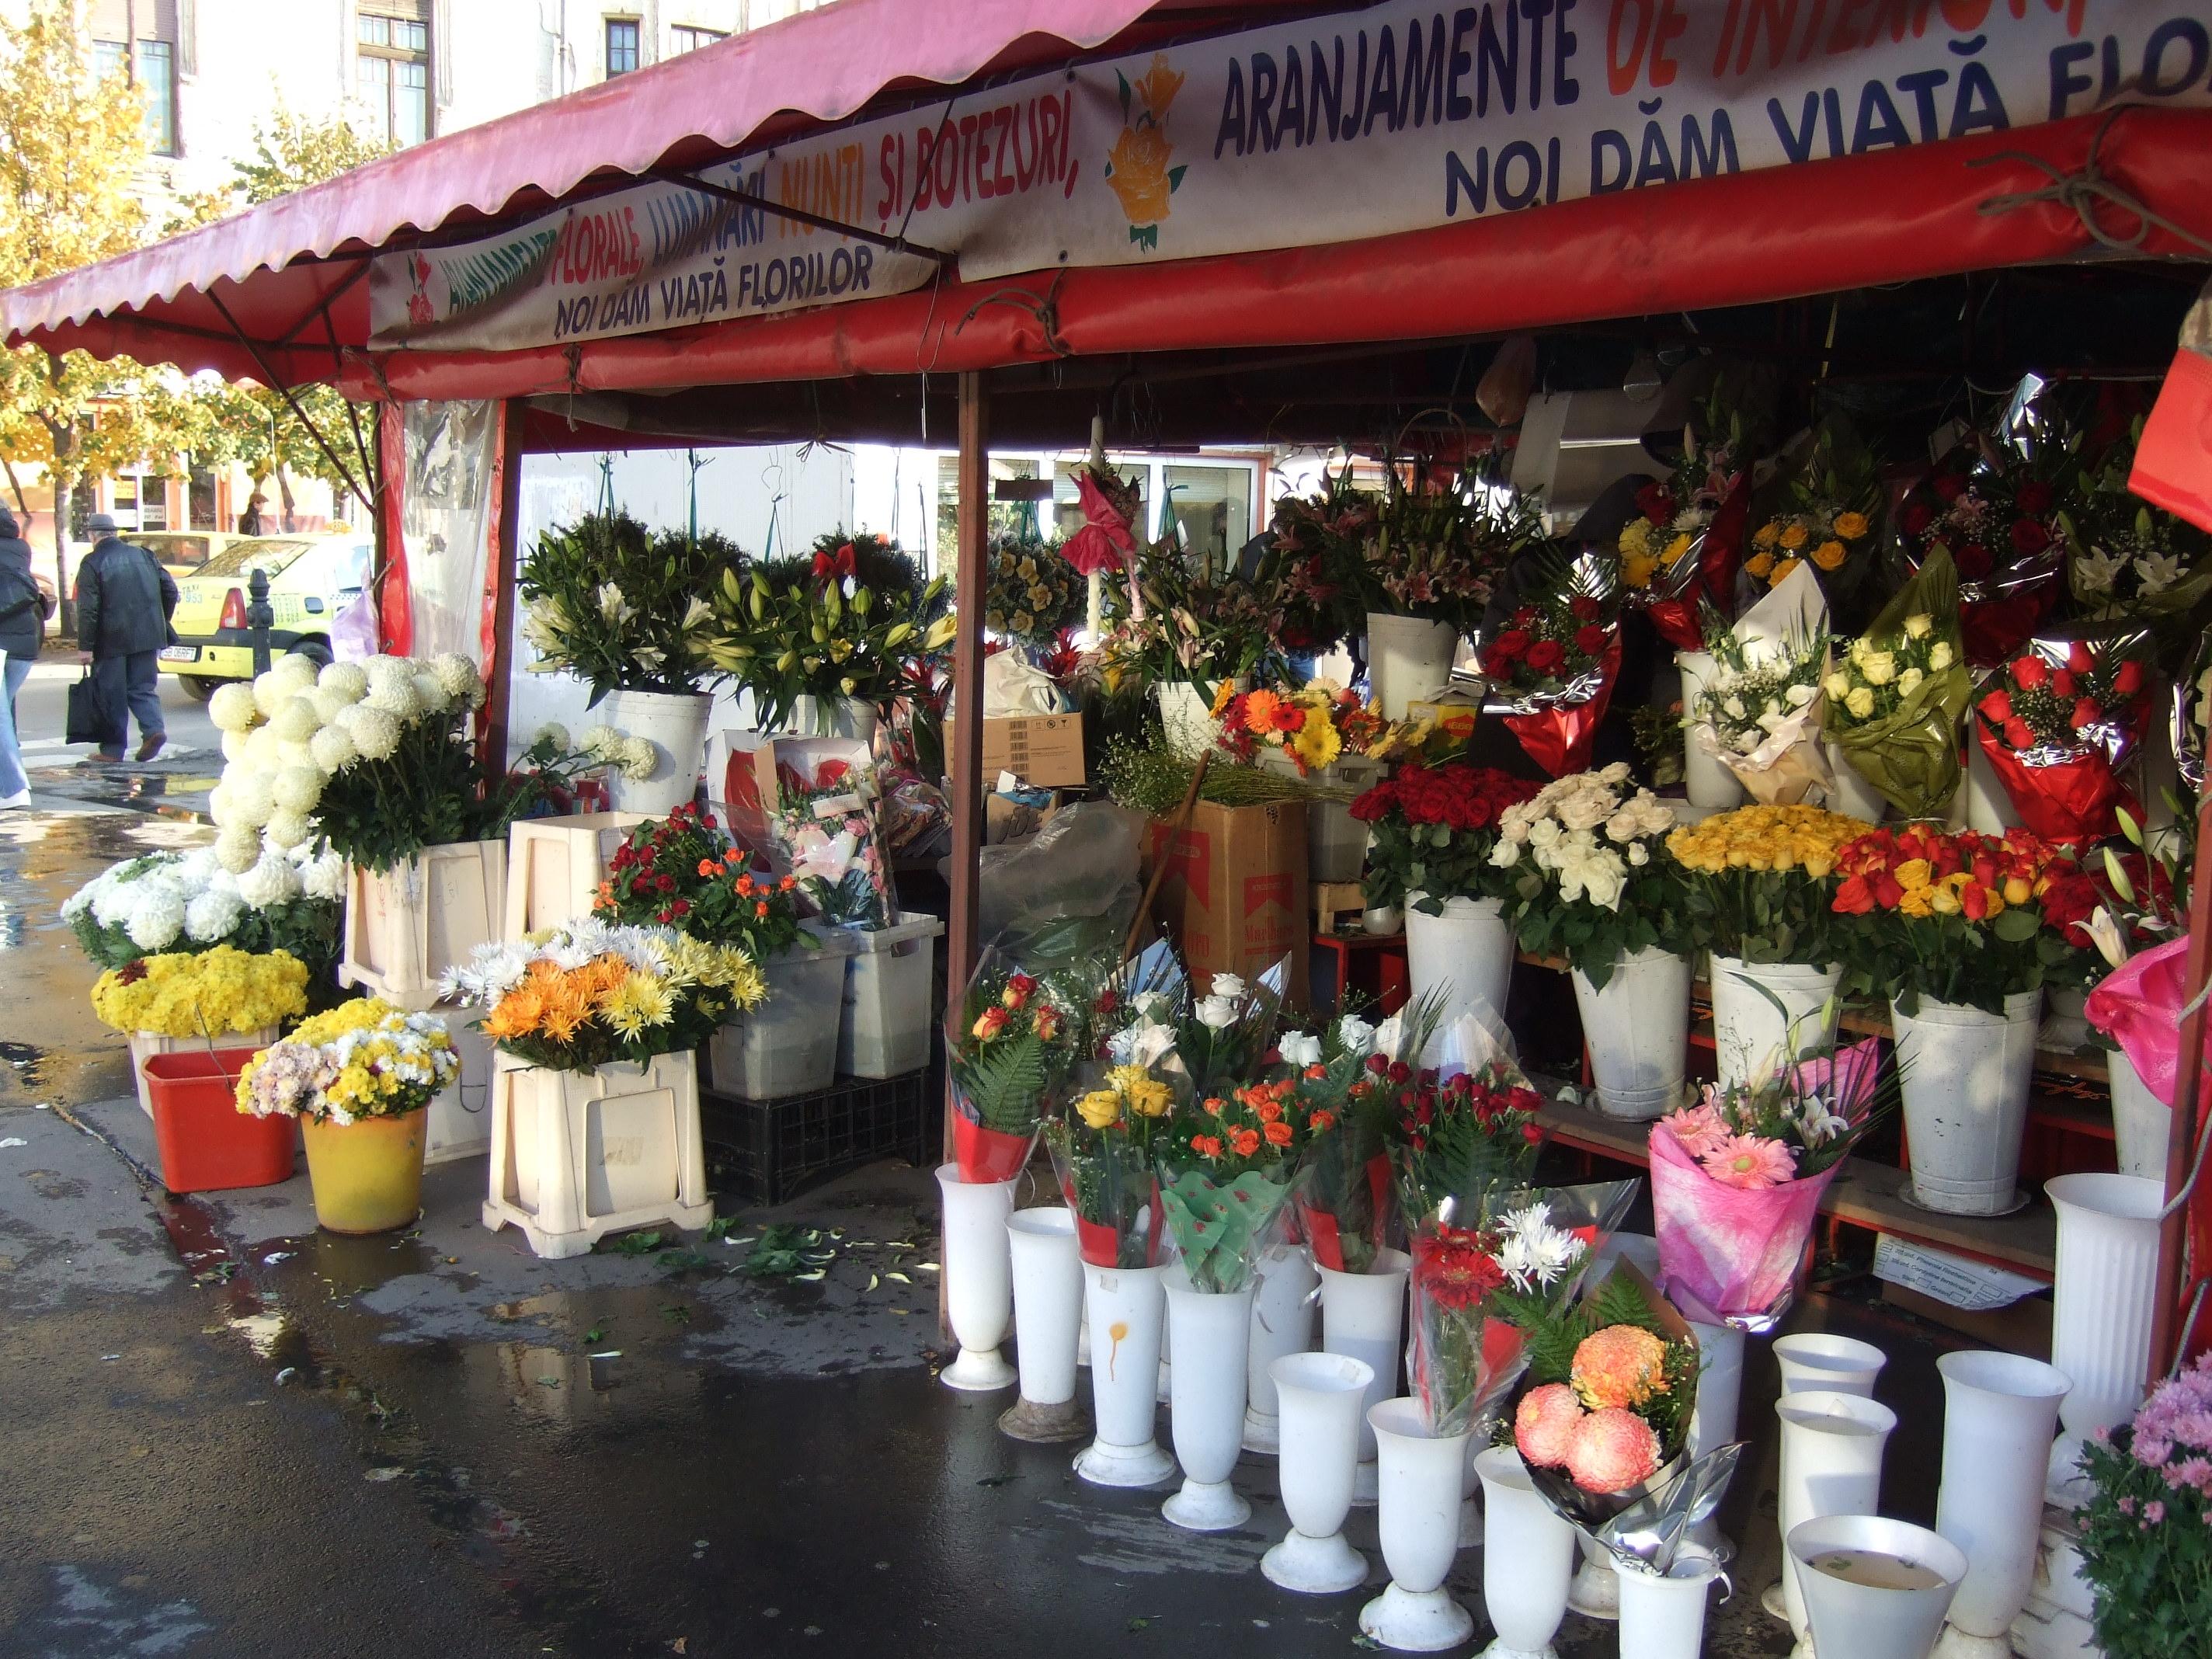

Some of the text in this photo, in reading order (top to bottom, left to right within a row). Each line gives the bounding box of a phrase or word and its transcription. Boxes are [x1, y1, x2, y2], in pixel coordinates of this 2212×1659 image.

[1214, 0, 1579, 159] ARANJAMENTE
[1606, 0, 1689, 96] DE
[552, 206, 644, 285] FLORALE,
[915, 89, 1079, 211] BOTEZURI,
[1445, 137, 1560, 217] NOI
[1590, 96, 1740, 196] DĂM
[555, 294, 598, 336] NOI
[739, 245, 873, 308] FLORILOR
